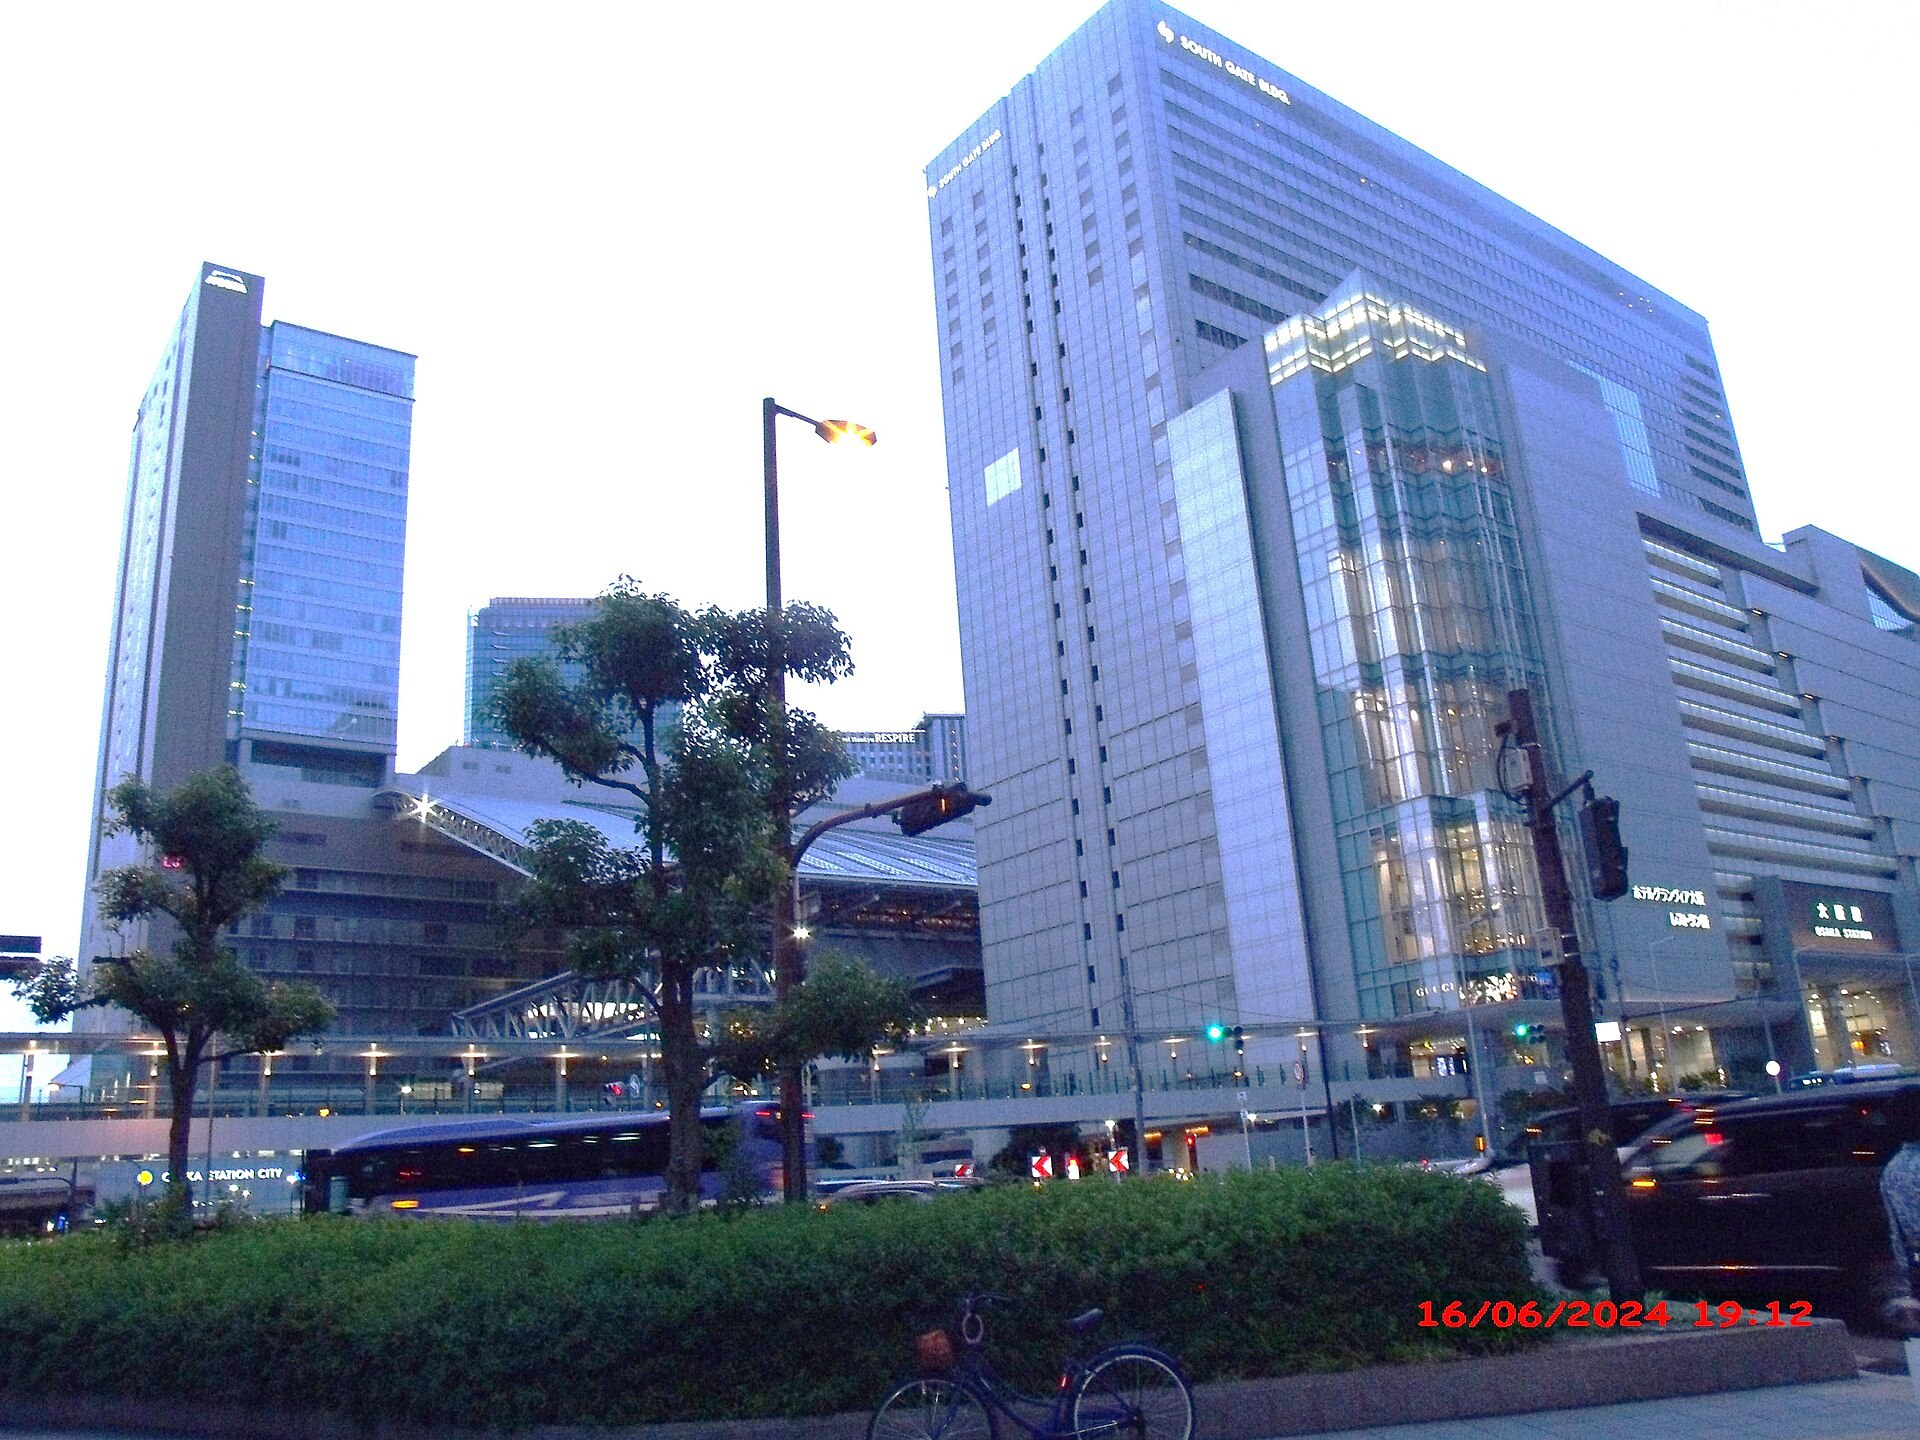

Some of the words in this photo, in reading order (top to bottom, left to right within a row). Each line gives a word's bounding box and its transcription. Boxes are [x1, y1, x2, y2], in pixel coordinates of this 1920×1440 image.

[1180, 35, 1223, 68] SOUTH
[1224, 60, 1256, 87] GATE
[874, 733, 916, 743] RESPIRE
[161, 1170, 203, 1183] OKA
[257, 1167, 283, 1179] CITY
